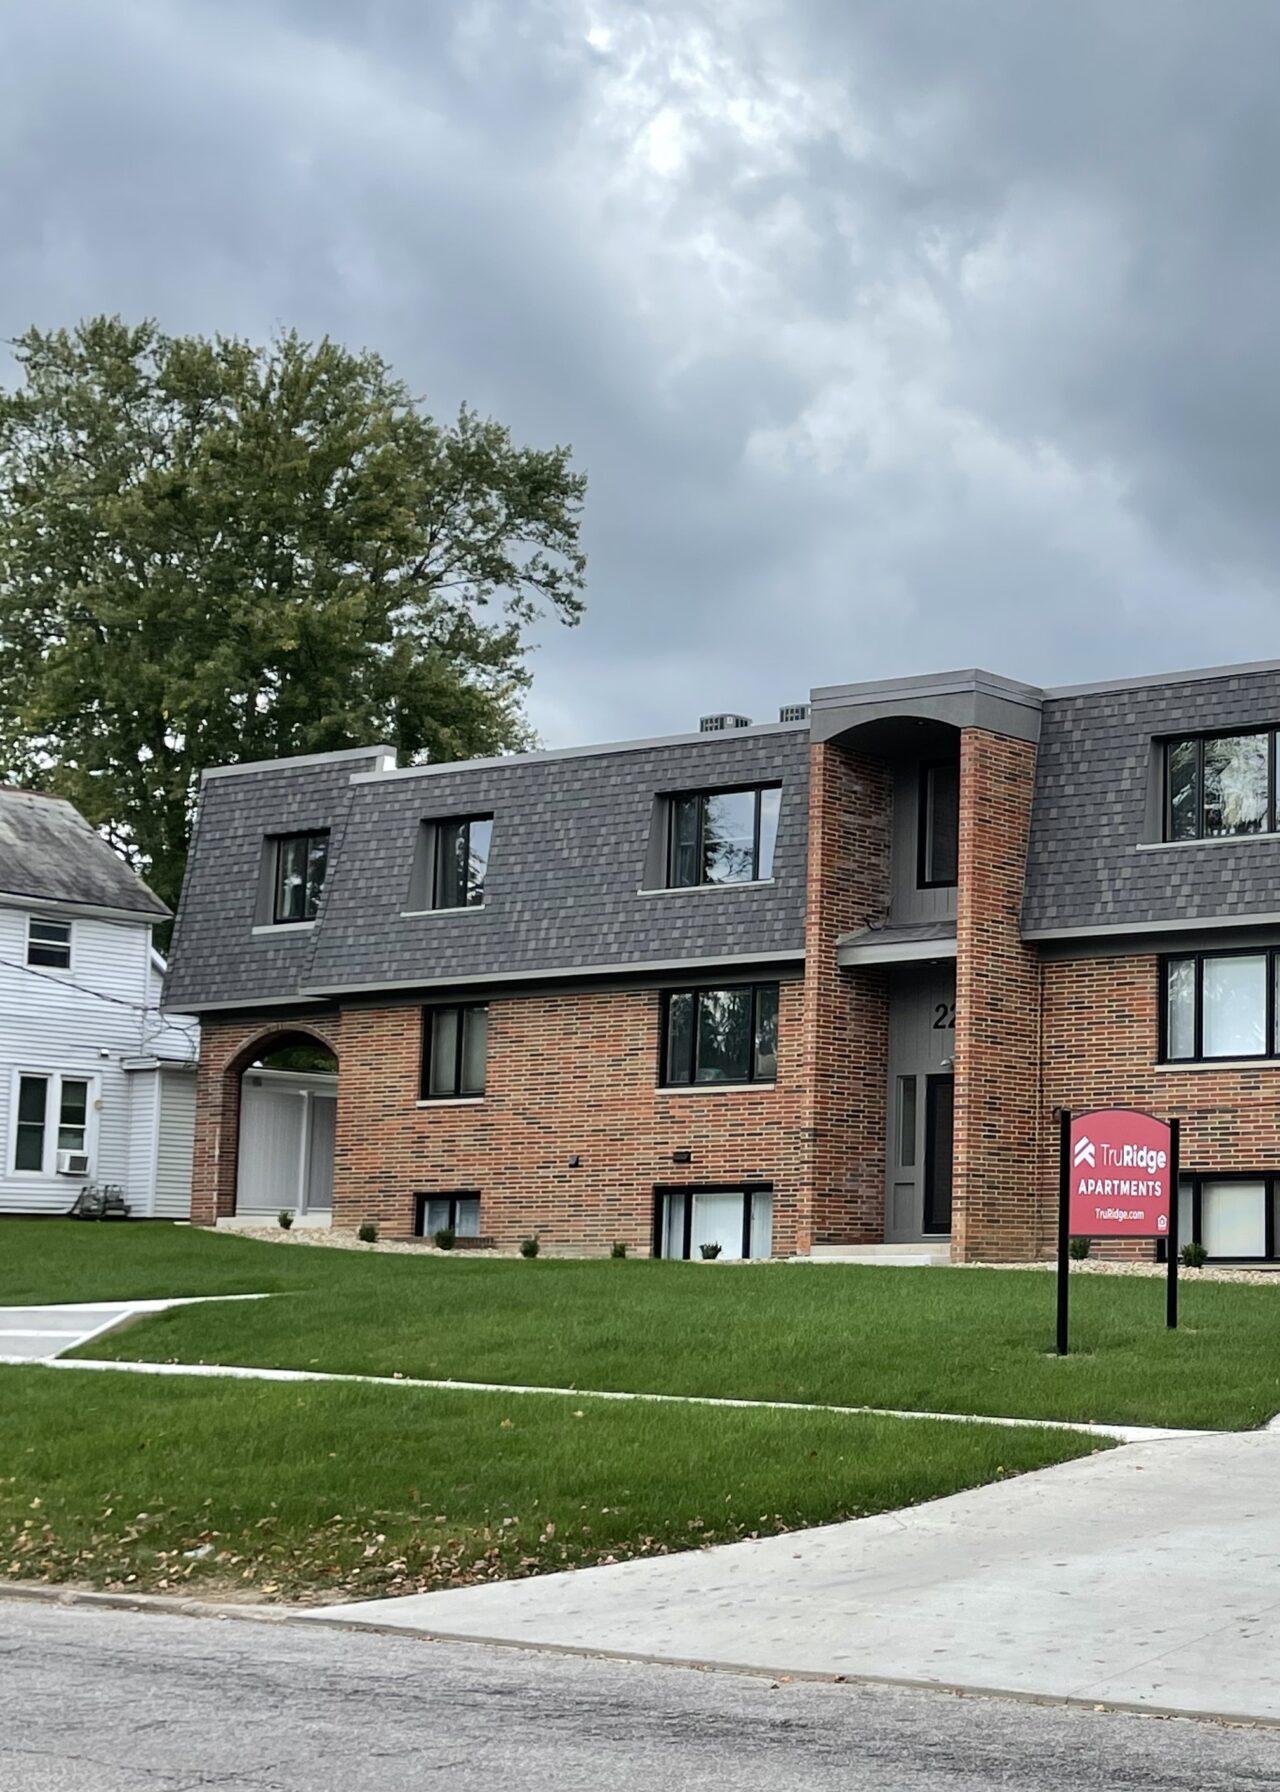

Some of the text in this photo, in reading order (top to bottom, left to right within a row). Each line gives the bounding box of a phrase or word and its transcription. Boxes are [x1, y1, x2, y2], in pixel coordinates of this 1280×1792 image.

[1100, 1144, 1167, 1174] TruRidge
[1078, 1179, 1162, 1197] APARTMENTS
[1095, 1208, 1144, 1222] TruRidge.com
